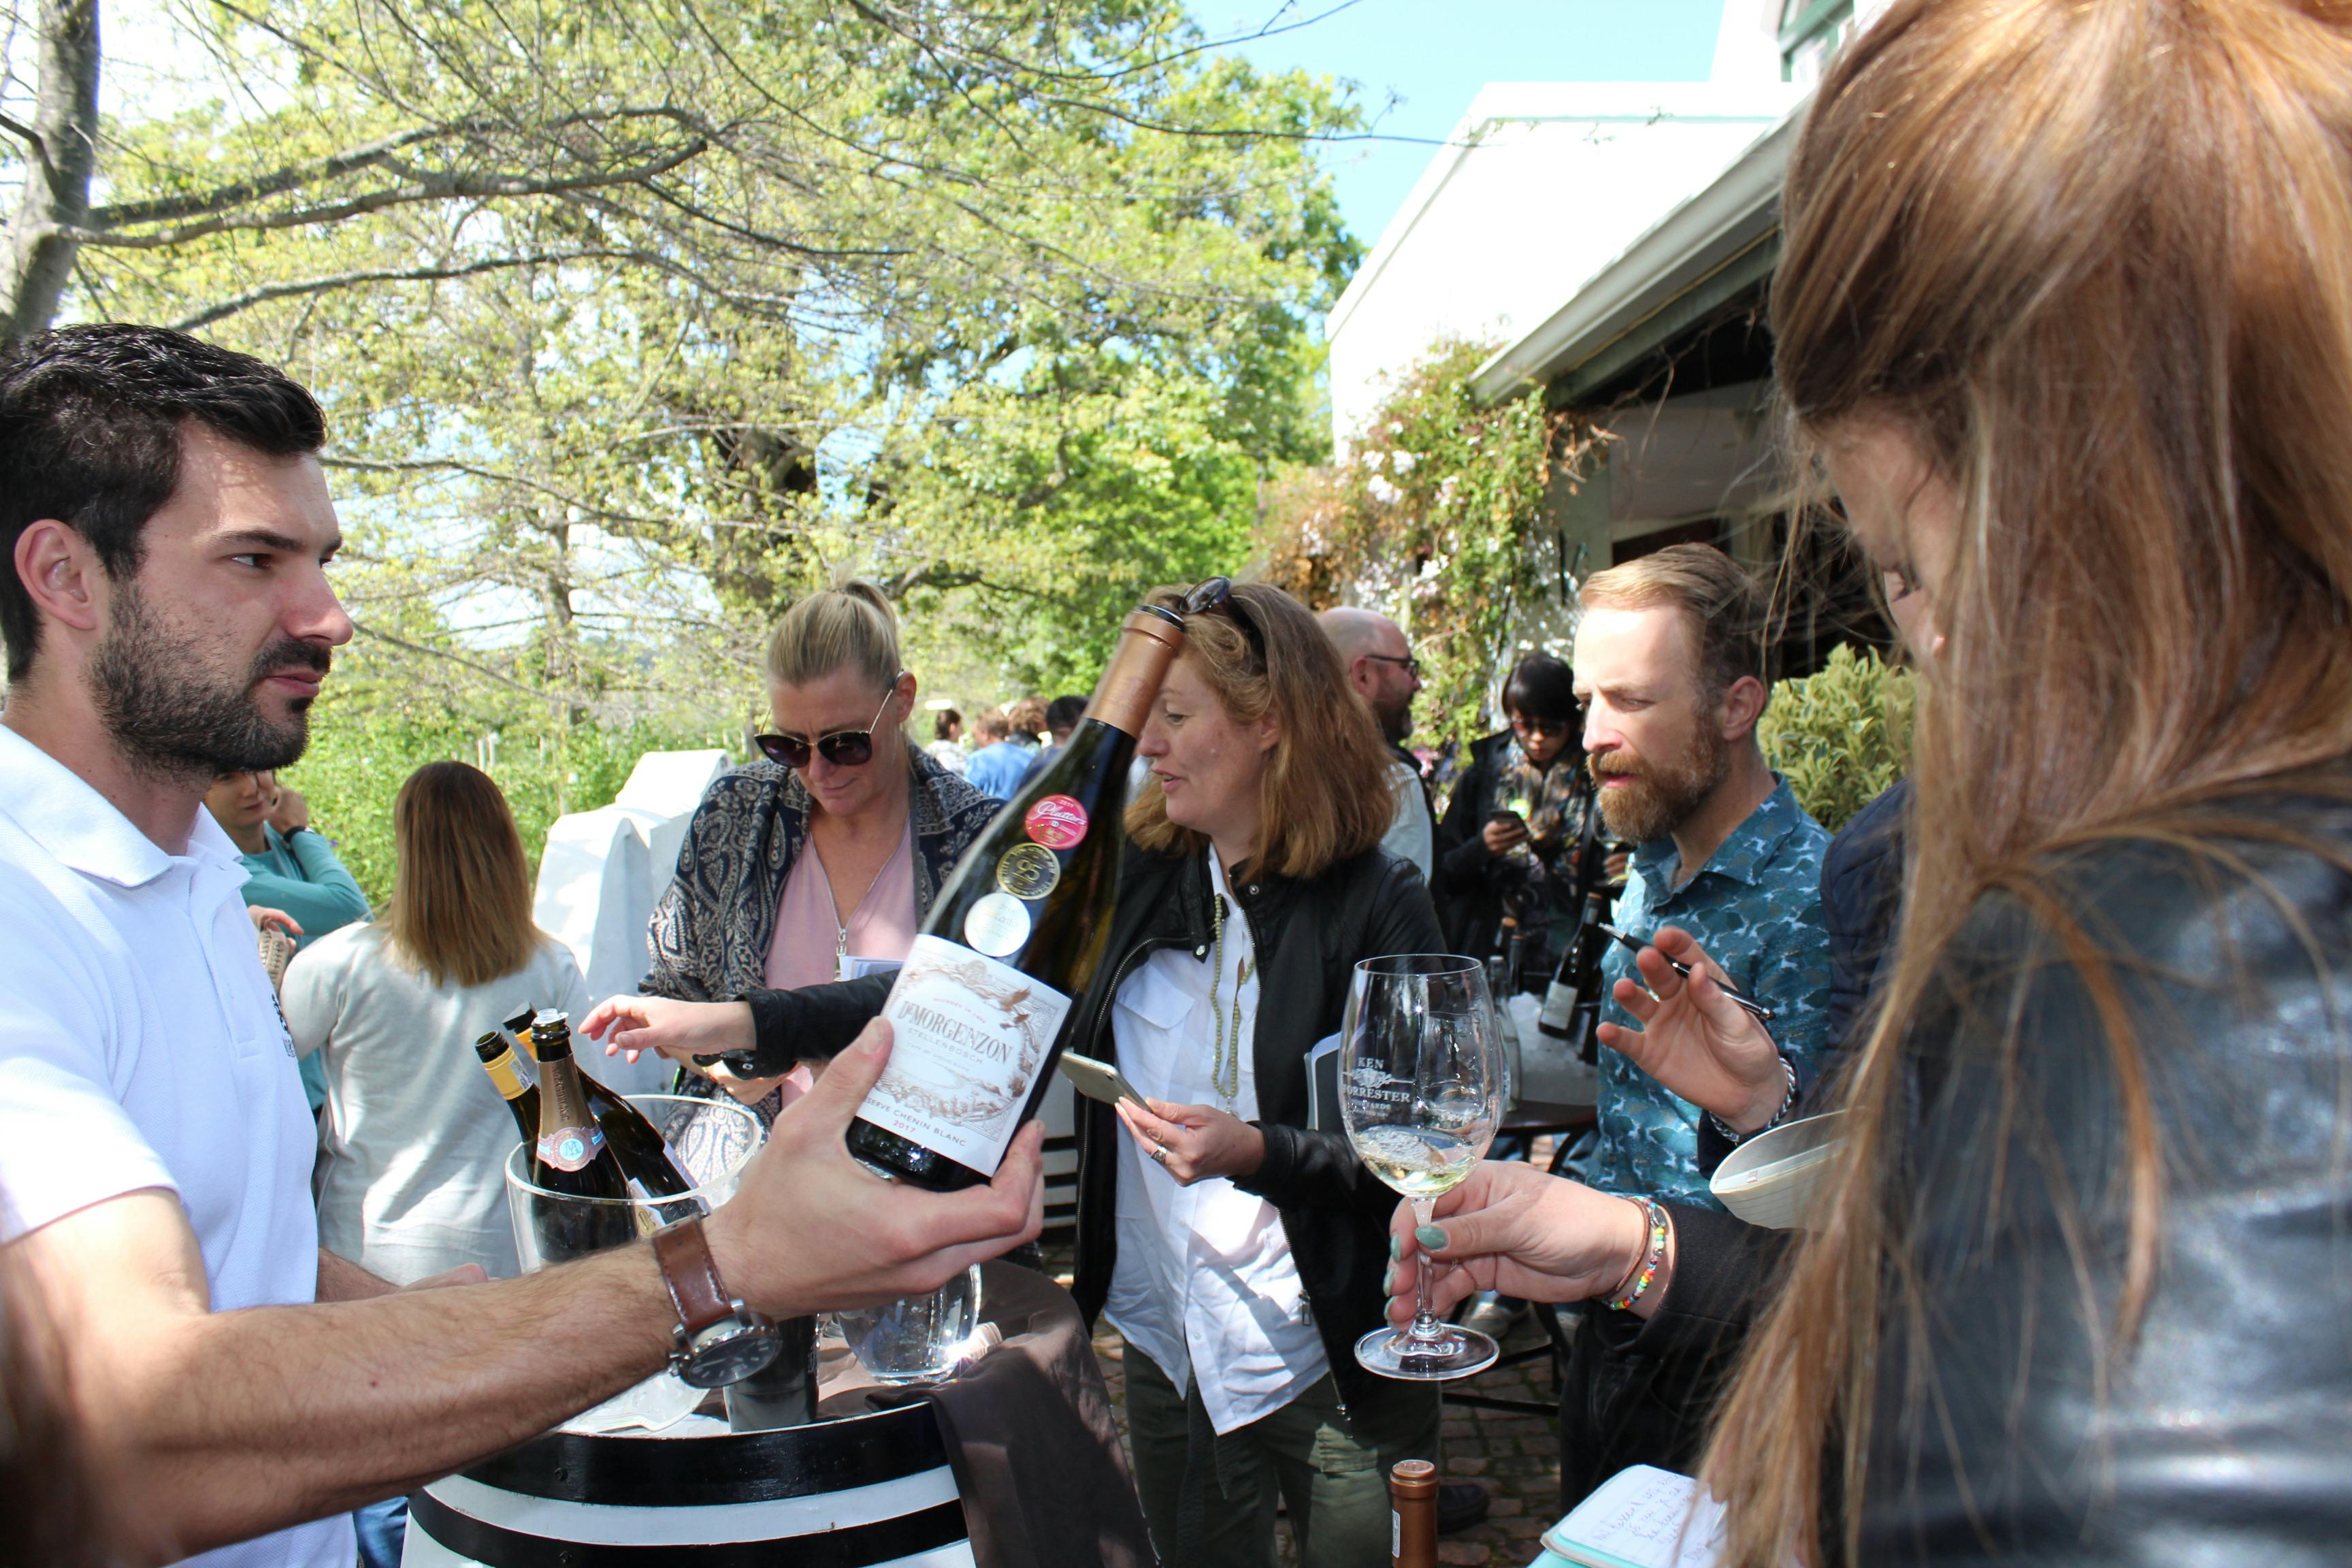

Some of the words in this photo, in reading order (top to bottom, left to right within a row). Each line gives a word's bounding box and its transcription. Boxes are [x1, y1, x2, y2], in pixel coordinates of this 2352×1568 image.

[1017, 860, 1041, 881] 95
[909, 1028, 983, 1064] STELLENBOSCH
[1358, 1056, 1384, 1069] KEN
[893, 1120, 915, 1133] 2017
[893, 1111, 930, 1130] CHENIN
[934, 1128, 966, 1147] BLANC
